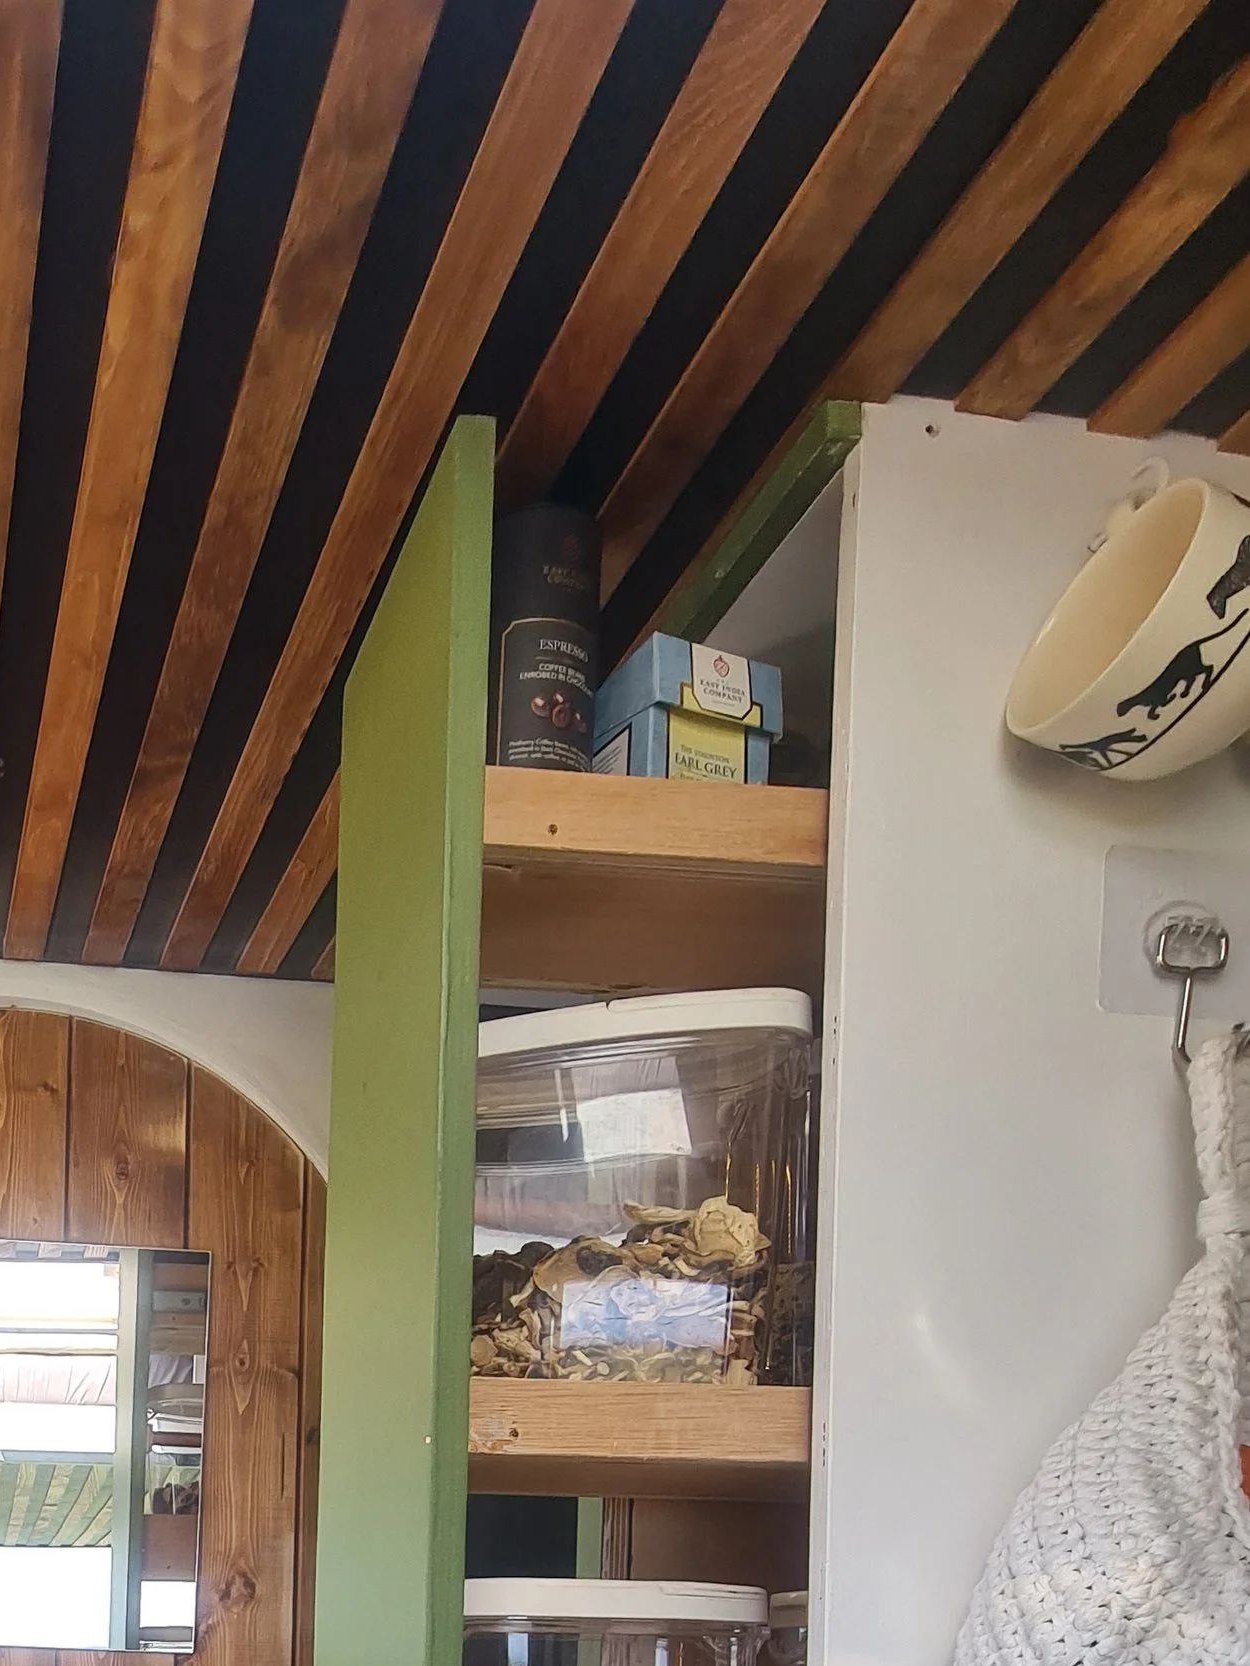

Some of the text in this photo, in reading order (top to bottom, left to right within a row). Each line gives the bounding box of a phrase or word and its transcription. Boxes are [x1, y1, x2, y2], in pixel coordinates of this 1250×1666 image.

[540, 639, 589, 663] ESPRESSO
[700, 679, 745, 696] EAST INDIA
[703, 687, 742, 703] COMPANY
[675, 752, 737, 779] EARL GREY
